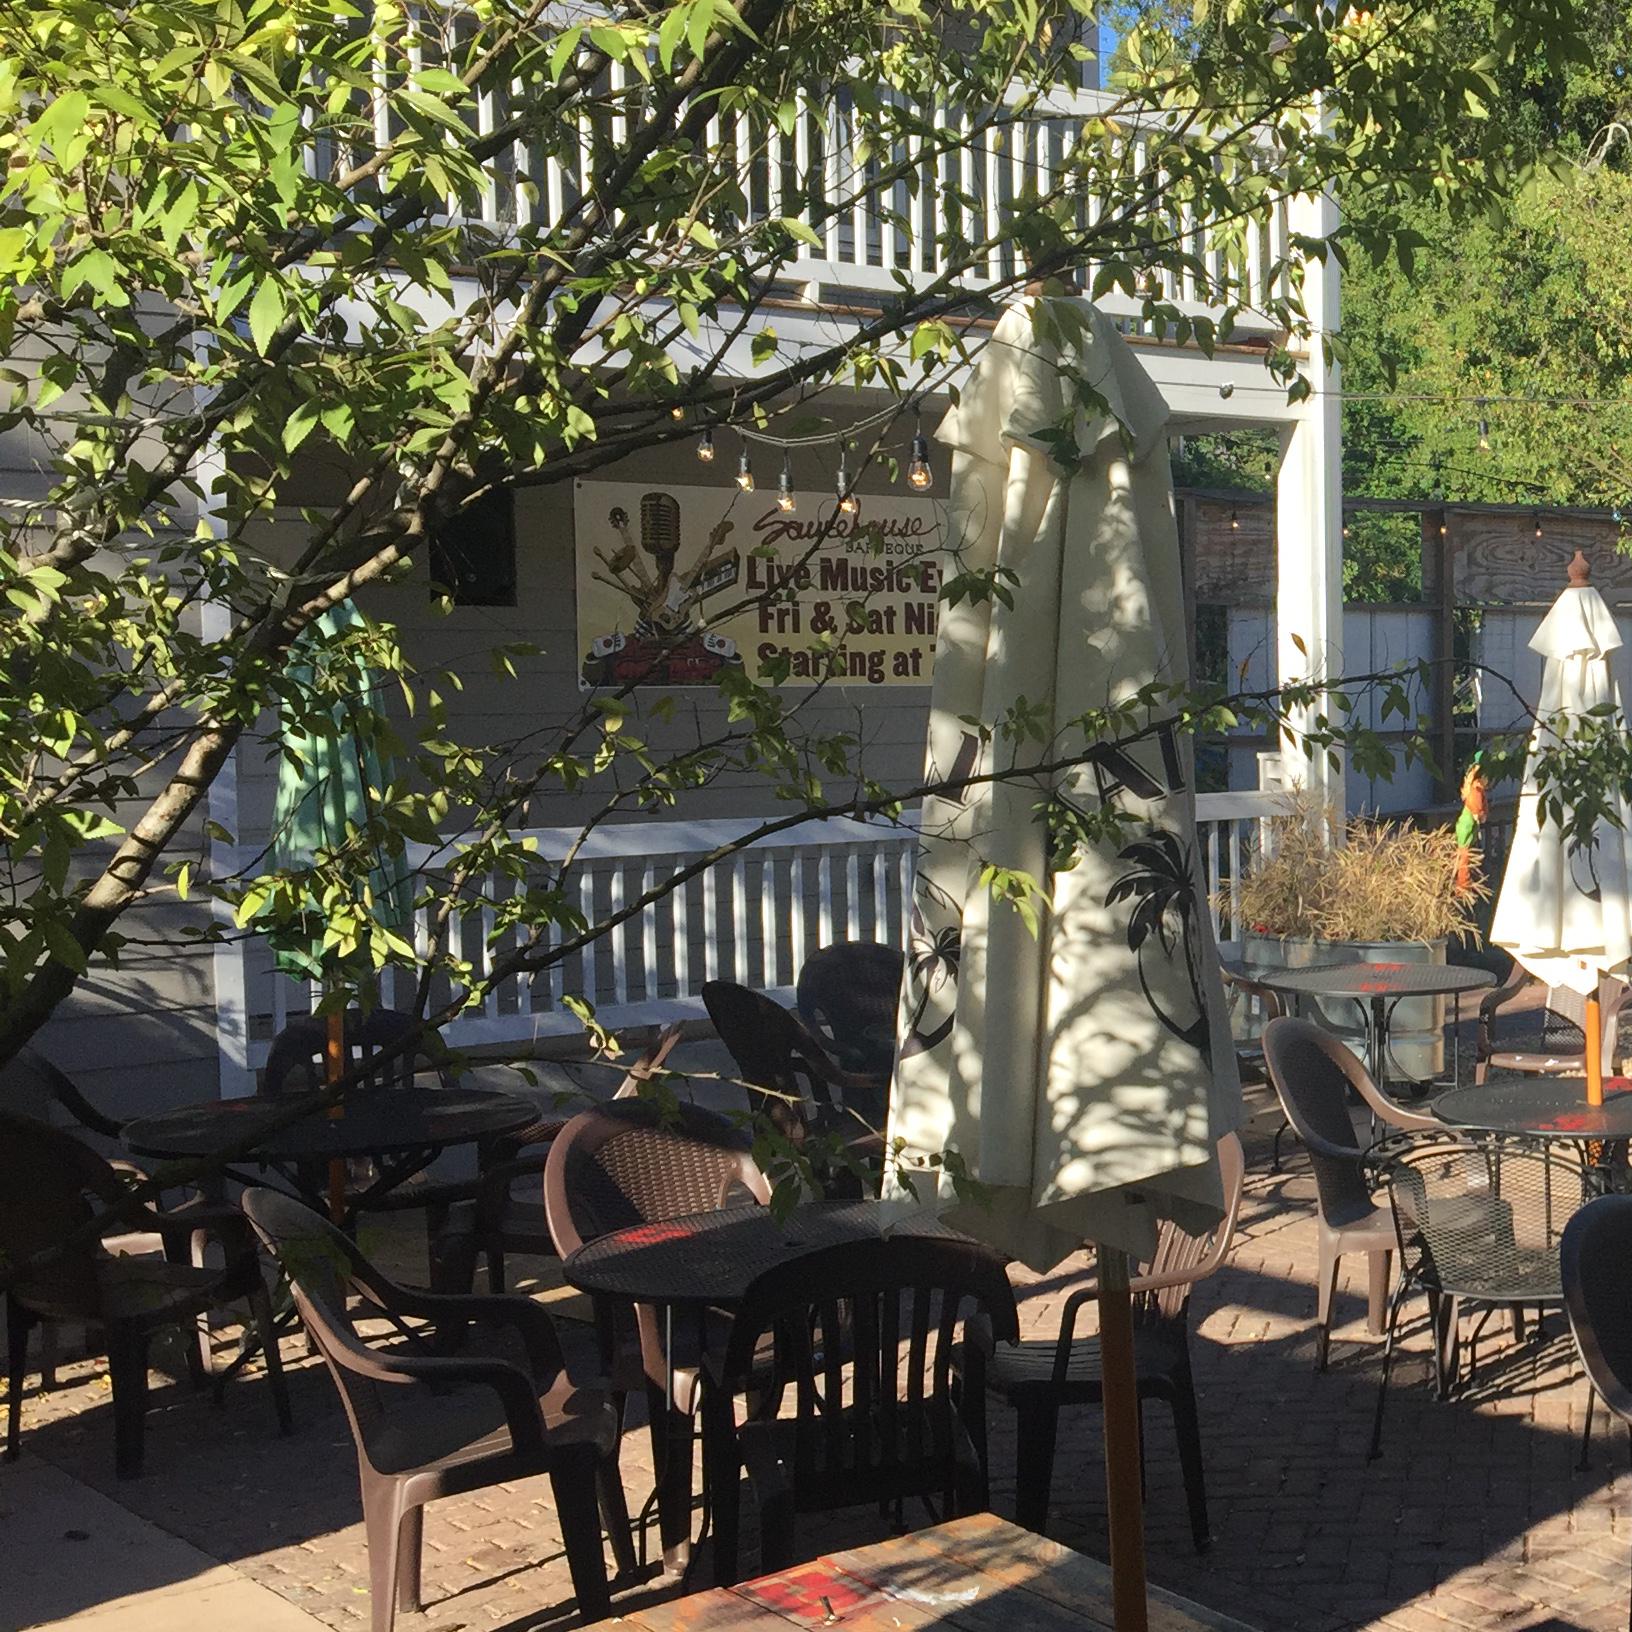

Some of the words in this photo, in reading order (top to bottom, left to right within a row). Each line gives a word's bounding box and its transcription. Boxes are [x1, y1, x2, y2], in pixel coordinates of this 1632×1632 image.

[746, 555, 811, 591] Live
[820, 557, 911, 593] Music
[759, 600, 800, 634] Fri
[810, 601, 838, 634] &
[847, 601, 896, 635] Sat
[905, 602, 939, 635] Ni
[893, 648, 922, 677] at
